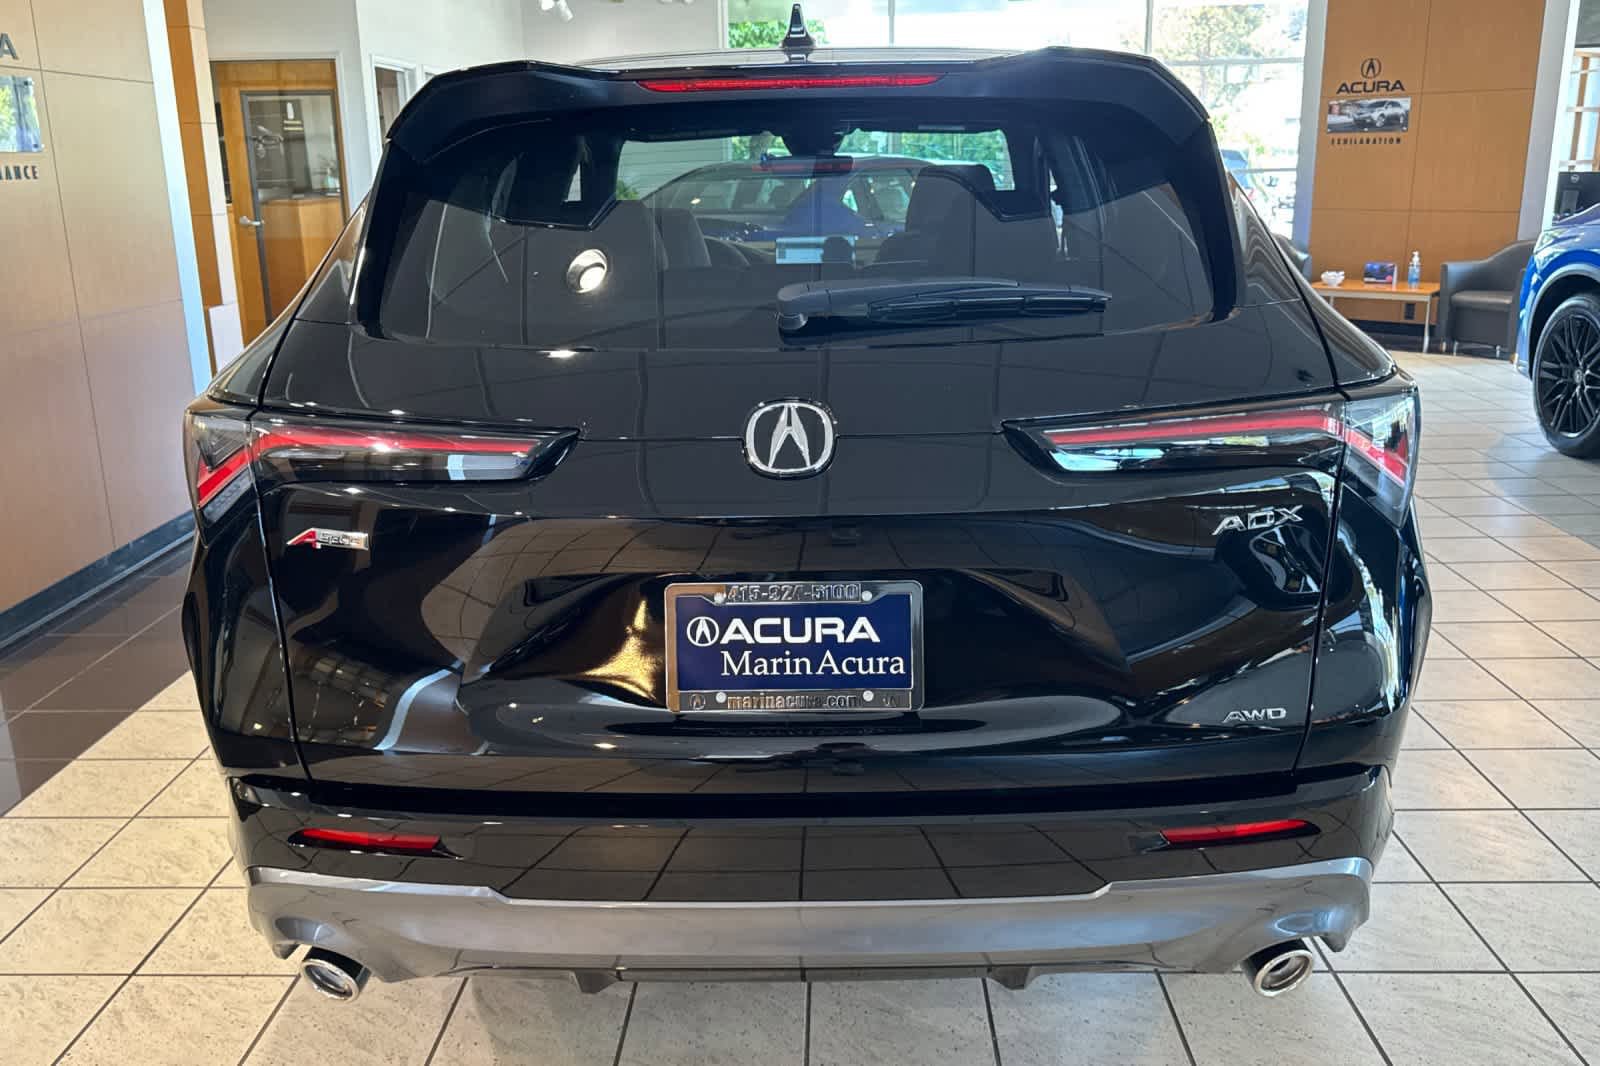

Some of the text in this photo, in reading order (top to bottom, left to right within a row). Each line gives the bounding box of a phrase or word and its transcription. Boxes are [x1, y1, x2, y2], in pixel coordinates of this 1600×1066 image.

[1336, 80, 1405, 94] ACURA
[0, 165, 38, 180] ANCE
[1212, 505, 1303, 535] ADX
[720, 616, 880, 644] ACURA
[720, 649, 906, 676] Marin Acura
[1222, 708, 1287, 723] AWD
